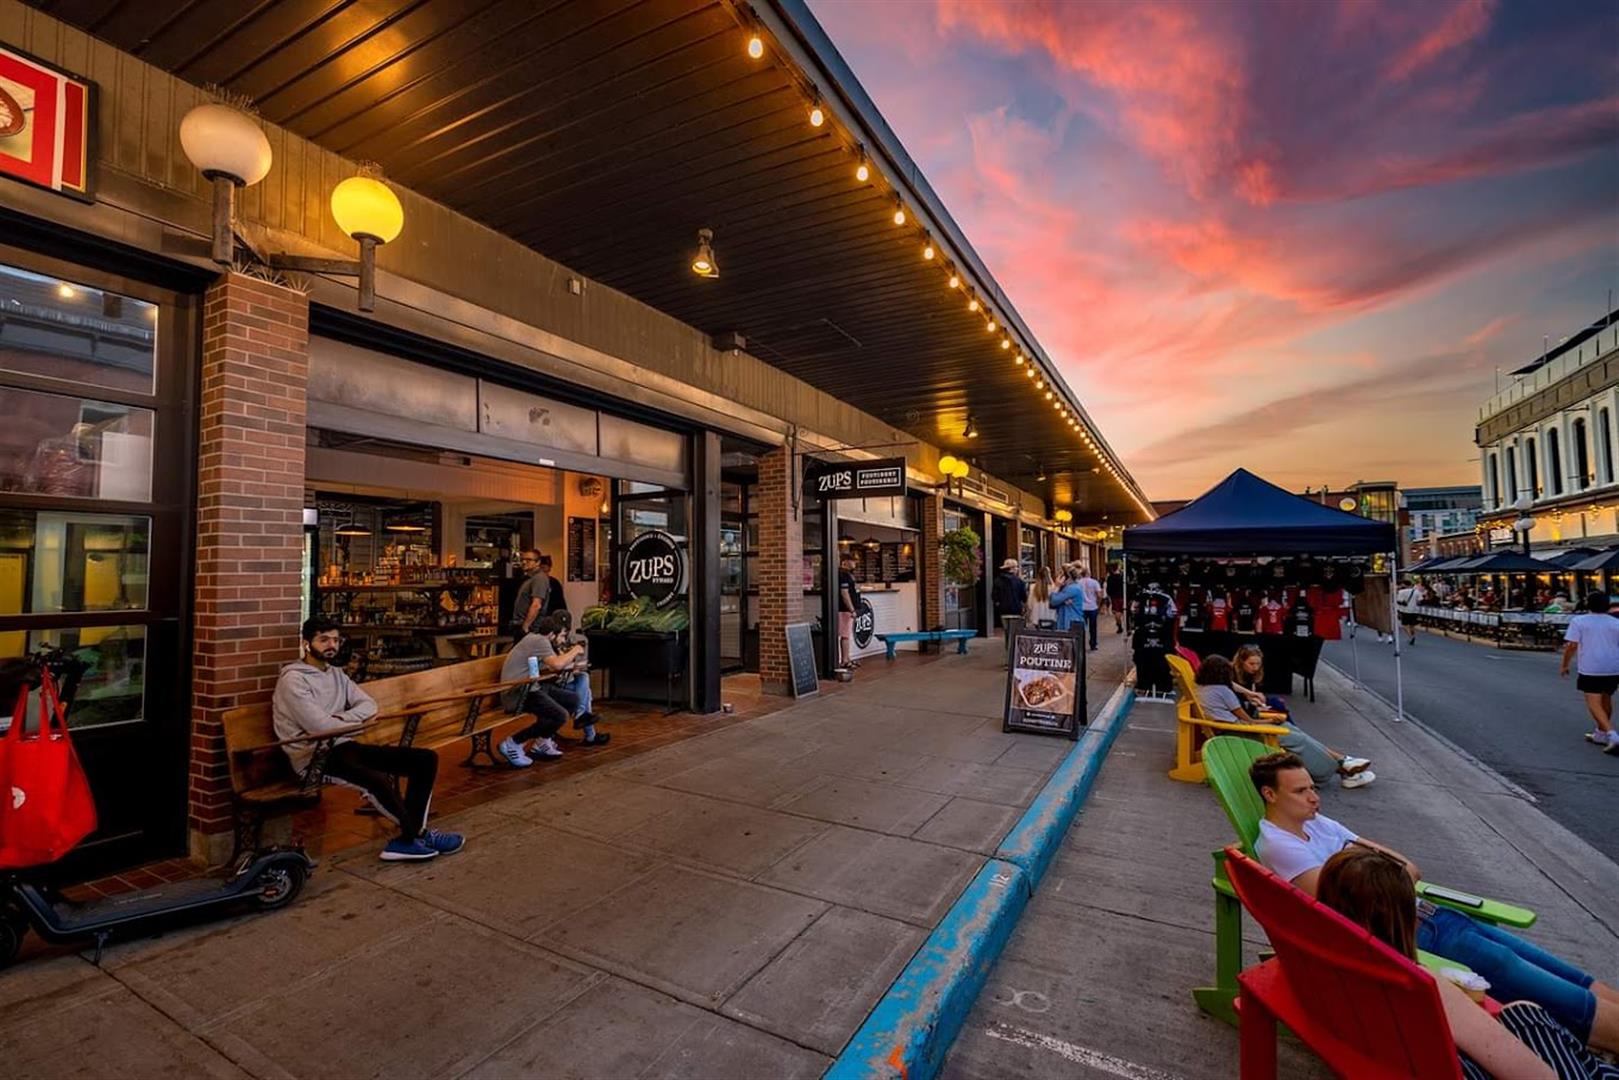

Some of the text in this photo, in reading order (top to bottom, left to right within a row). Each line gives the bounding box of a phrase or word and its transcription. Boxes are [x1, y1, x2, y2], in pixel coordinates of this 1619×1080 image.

[818, 470, 852, 491] ZUPS
[629, 554, 674, 583] ZUPS
[1033, 642, 1059, 654] ZUPS
[1020, 656, 1072, 669] POUTINE
